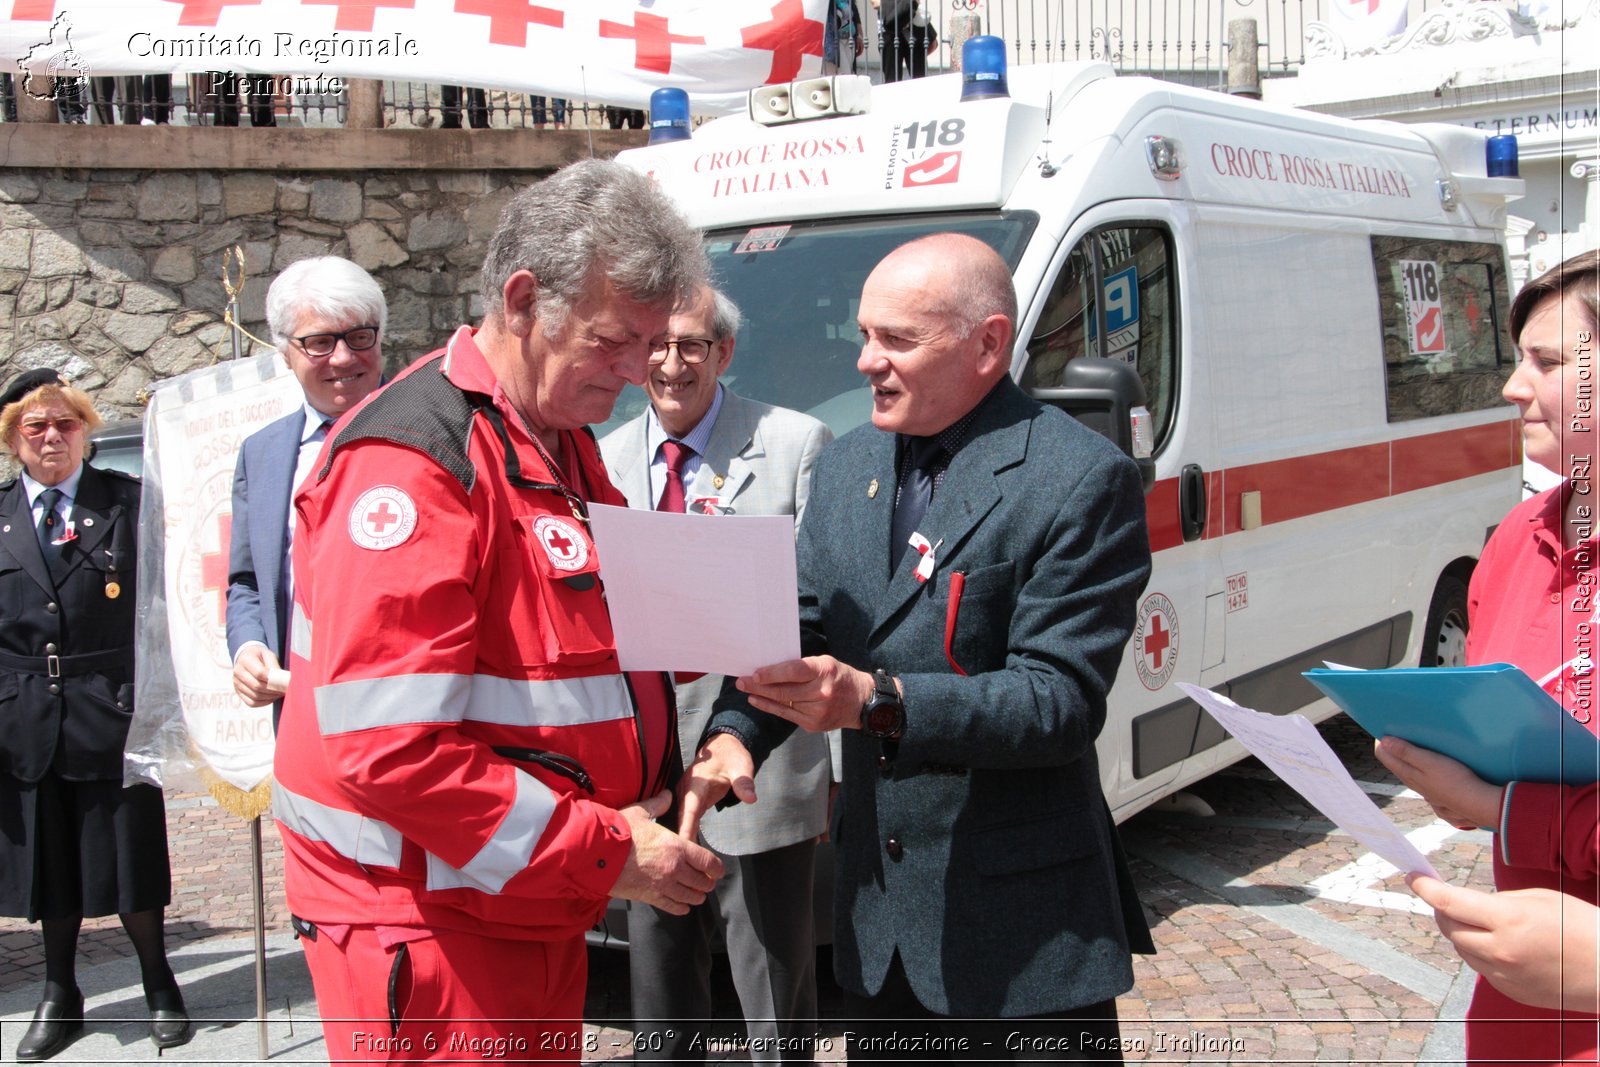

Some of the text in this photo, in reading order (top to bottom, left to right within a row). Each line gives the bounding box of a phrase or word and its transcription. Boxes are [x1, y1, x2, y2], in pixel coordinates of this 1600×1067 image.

[902, 118, 966, 149] 118
[1461, 107, 1598, 136] TERNUM
[693, 135, 865, 173] CROCE ROSSA
[885, 123, 901, 190] PIEMONTE
[1210, 142, 1412, 198] CROCE ROSSA ITALIANA
[712, 168, 830, 198] ITALIANA
[1406, 263, 1439, 302] 118
[218, 410, 236, 428] DEL
[1238, 575, 1247, 588] 10
[1135, 595, 1178, 651] CROCE ROSSA ITALIANA
